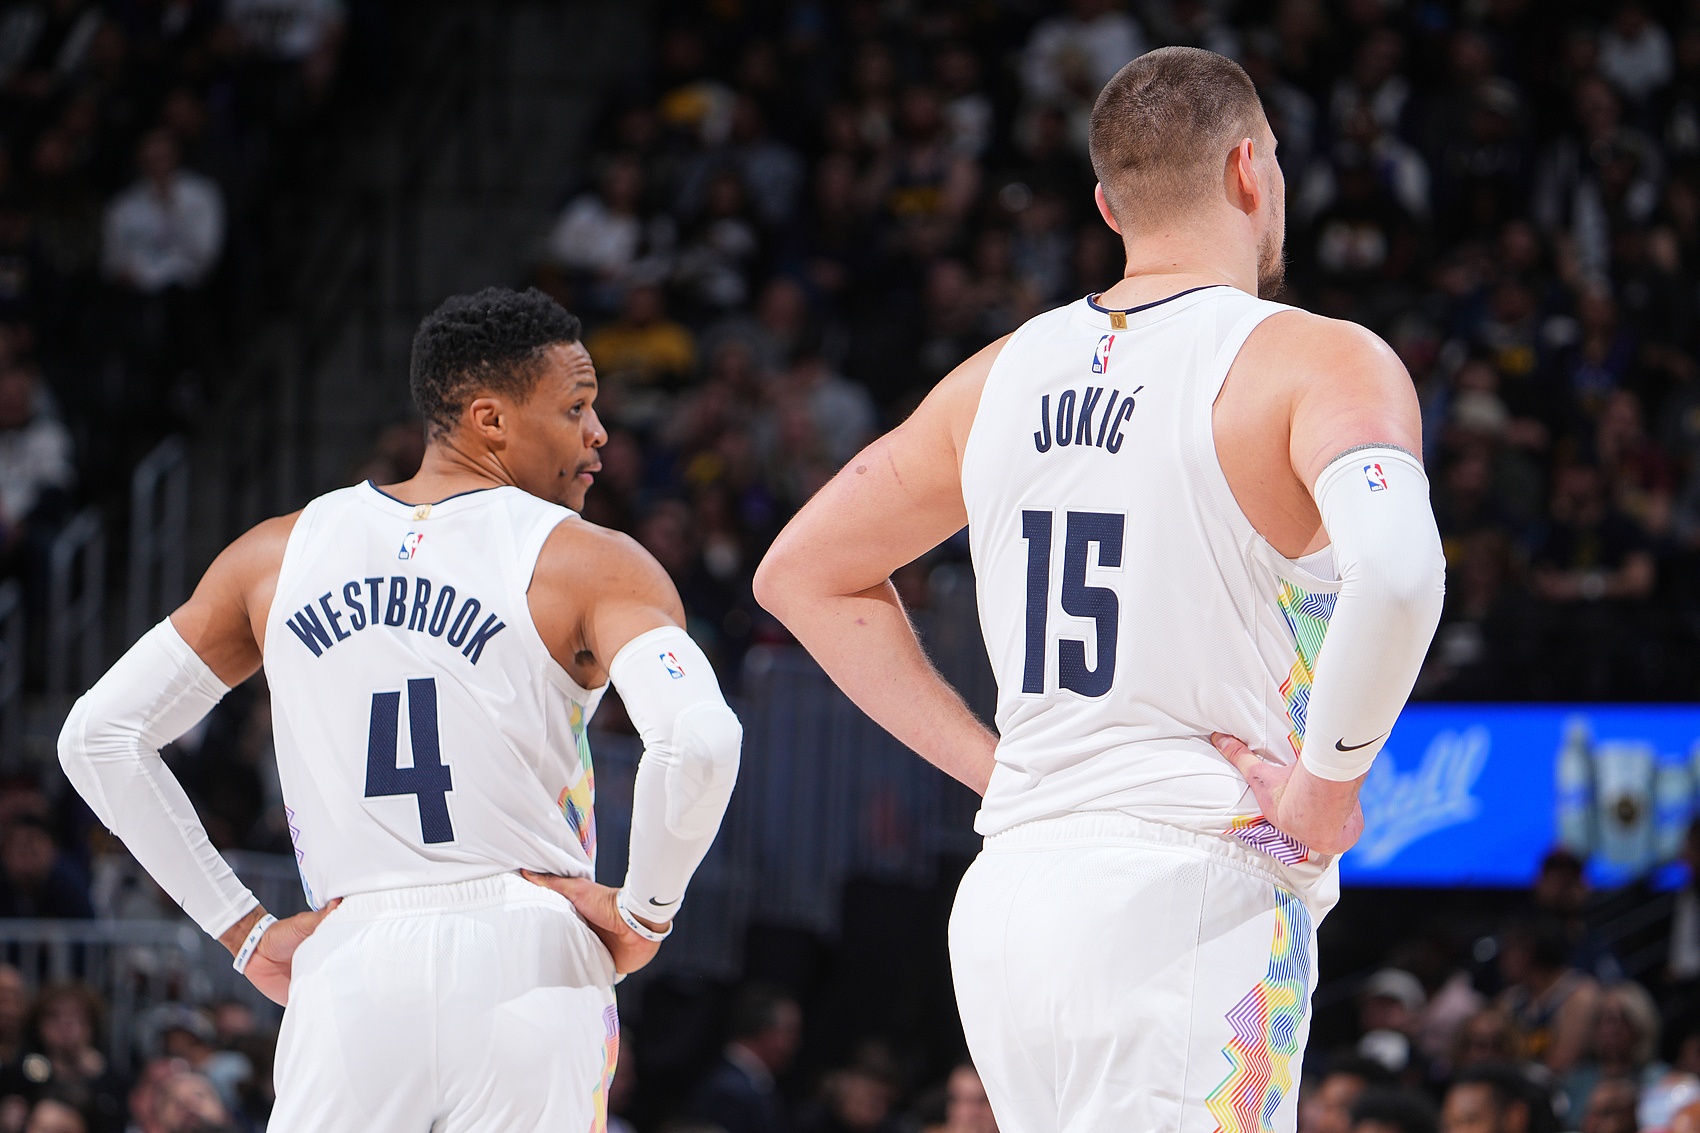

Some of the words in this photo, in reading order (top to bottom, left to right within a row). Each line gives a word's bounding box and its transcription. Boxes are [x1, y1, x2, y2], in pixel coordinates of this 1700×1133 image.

[1033, 385, 1145, 455] JOKIĆ
[285, 576, 507, 666] WESTBROOK
[1021, 509, 1126, 698] 15
[364, 677, 455, 844] 4
